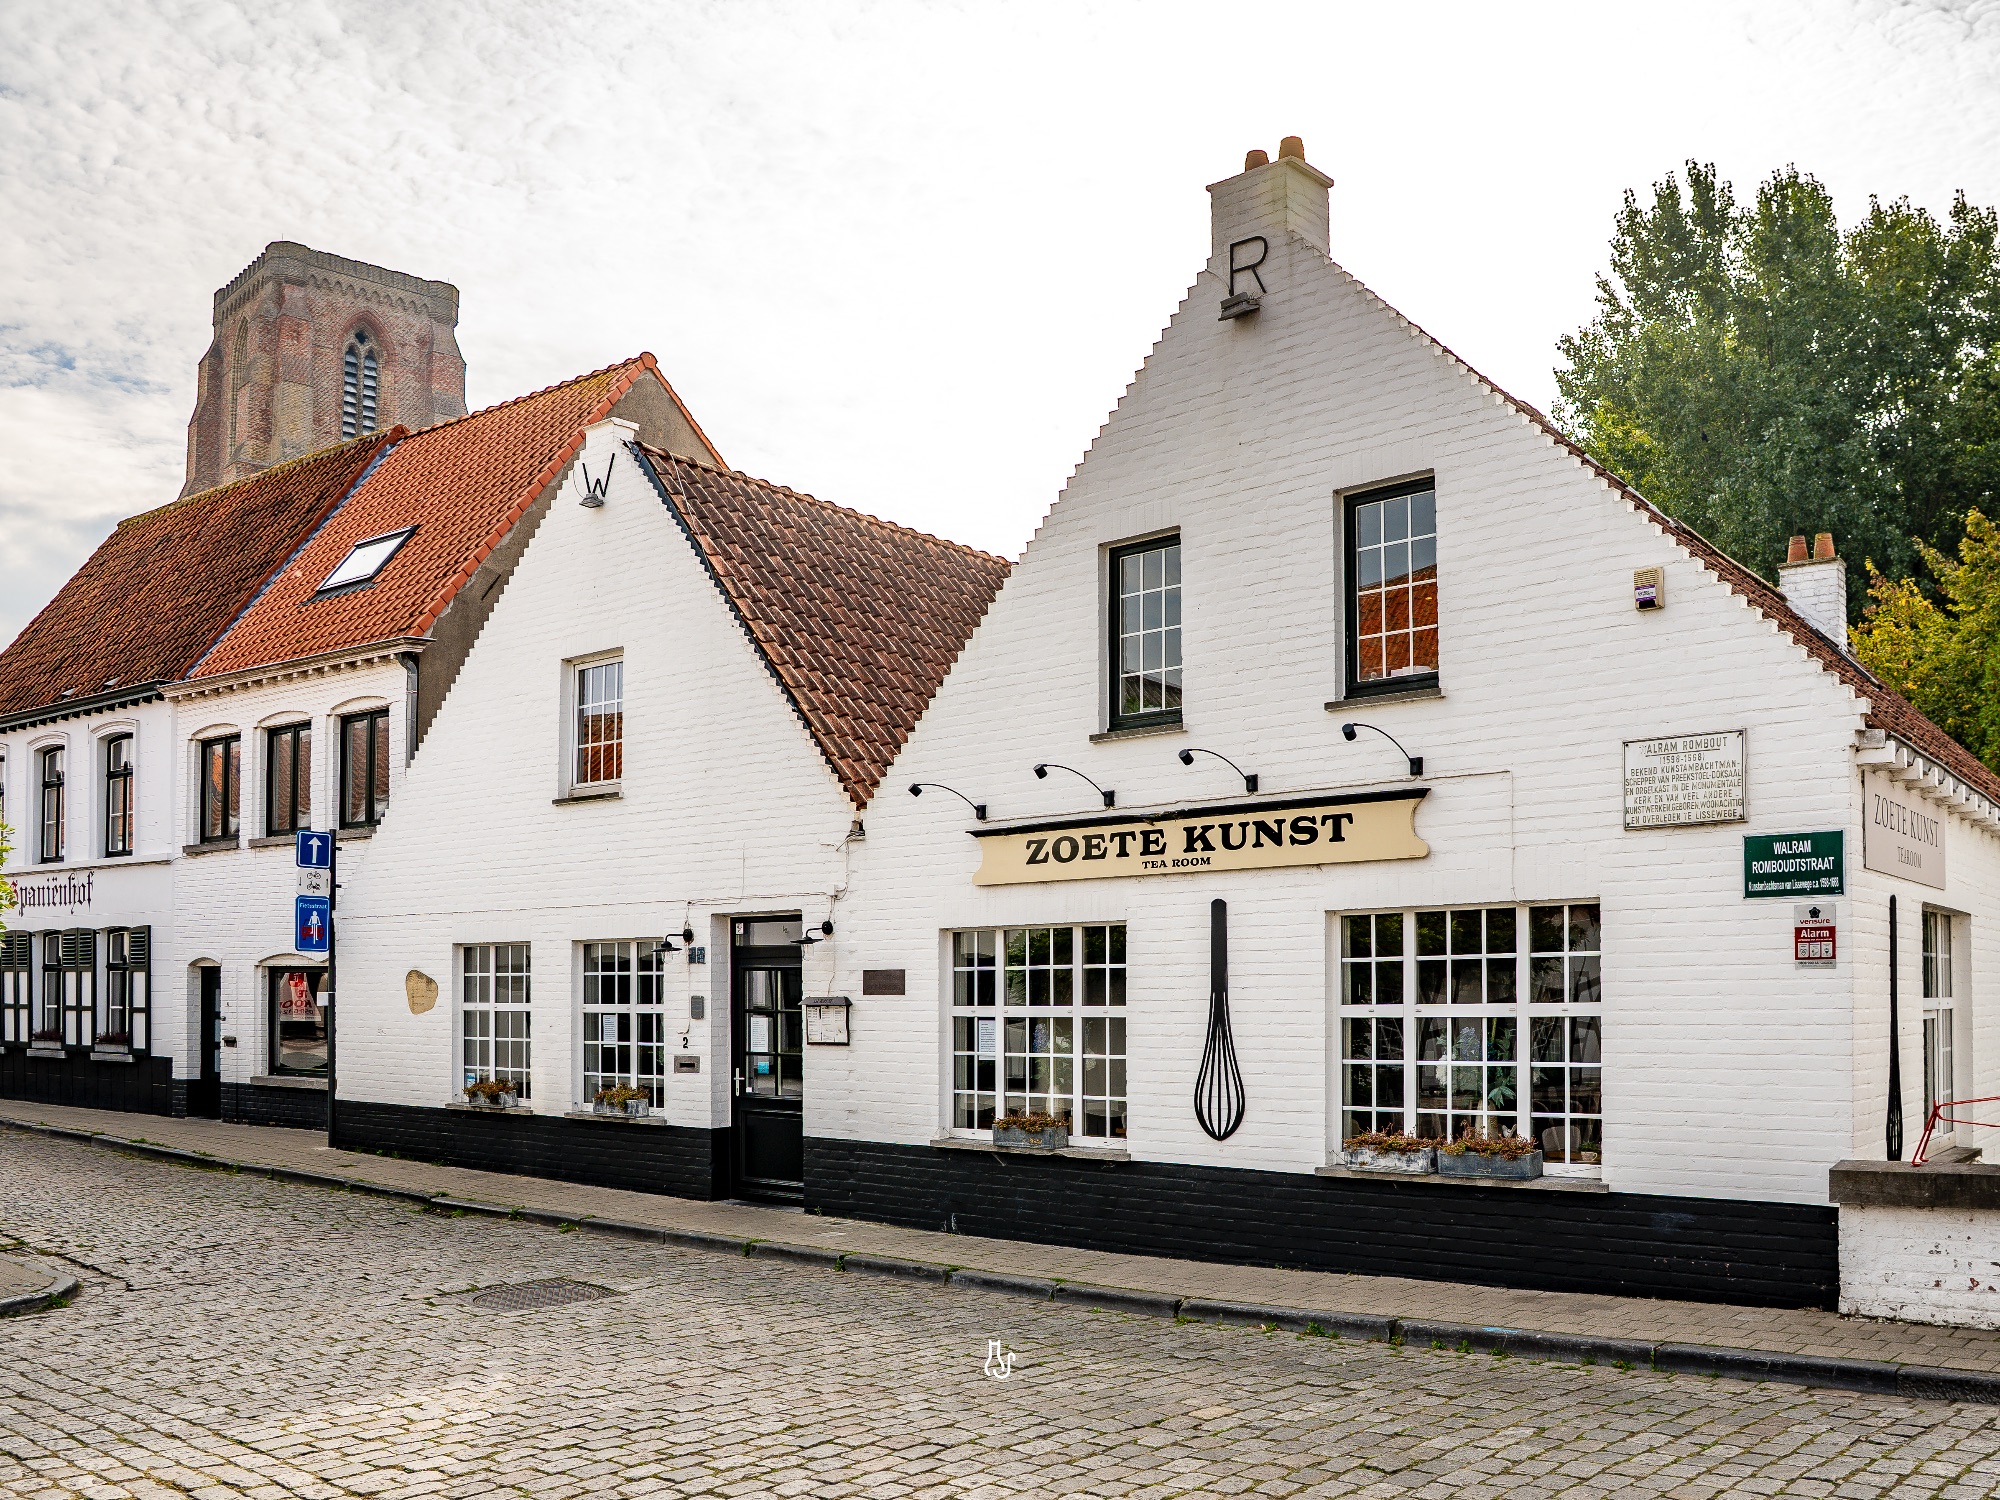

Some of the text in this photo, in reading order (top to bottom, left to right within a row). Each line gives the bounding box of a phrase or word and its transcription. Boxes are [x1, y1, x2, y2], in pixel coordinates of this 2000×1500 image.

[1229, 236, 1268, 297] R
[582, 453, 616, 497] W
[1683, 737, 1728, 750] ROMBOUT
[1630, 766, 1658, 777] BEKEND
[1625, 776, 1656, 788] SCHEPPER
[1658, 774, 1670, 784] VAN
[1625, 779, 1742, 796] EN ORGELKAST IN DE MONUMENTALE
[1634, 796, 1652, 805] KERK
[1654, 795, 1663, 804] EN
[1666, 793, 1679, 802] VAN
[1682, 792, 1700, 801] VEEL
[1703, 788, 1733, 799] ANDERE
[1631, 816, 1640, 825] EN
[1642, 812, 1681, 824] OVERLEDEN
[1683, 812, 1692, 820] TE
[1875, 794, 1939, 848] ZOETE KUNST
[1026, 813, 1354, 865] ZOETE KUNST
[1773, 840, 1812, 854] WALRAM
[1142, 857, 1211, 869] TEA ROOM
[1897, 846, 1922, 869] TEAROOM
[1752, 857, 1835, 874] ROMBOUDTSTRAAT
[1792, 879, 1812, 892] Lissewege
[1801, 929, 1830, 938] Alarm
[682, 1036, 689, 1049] 2
